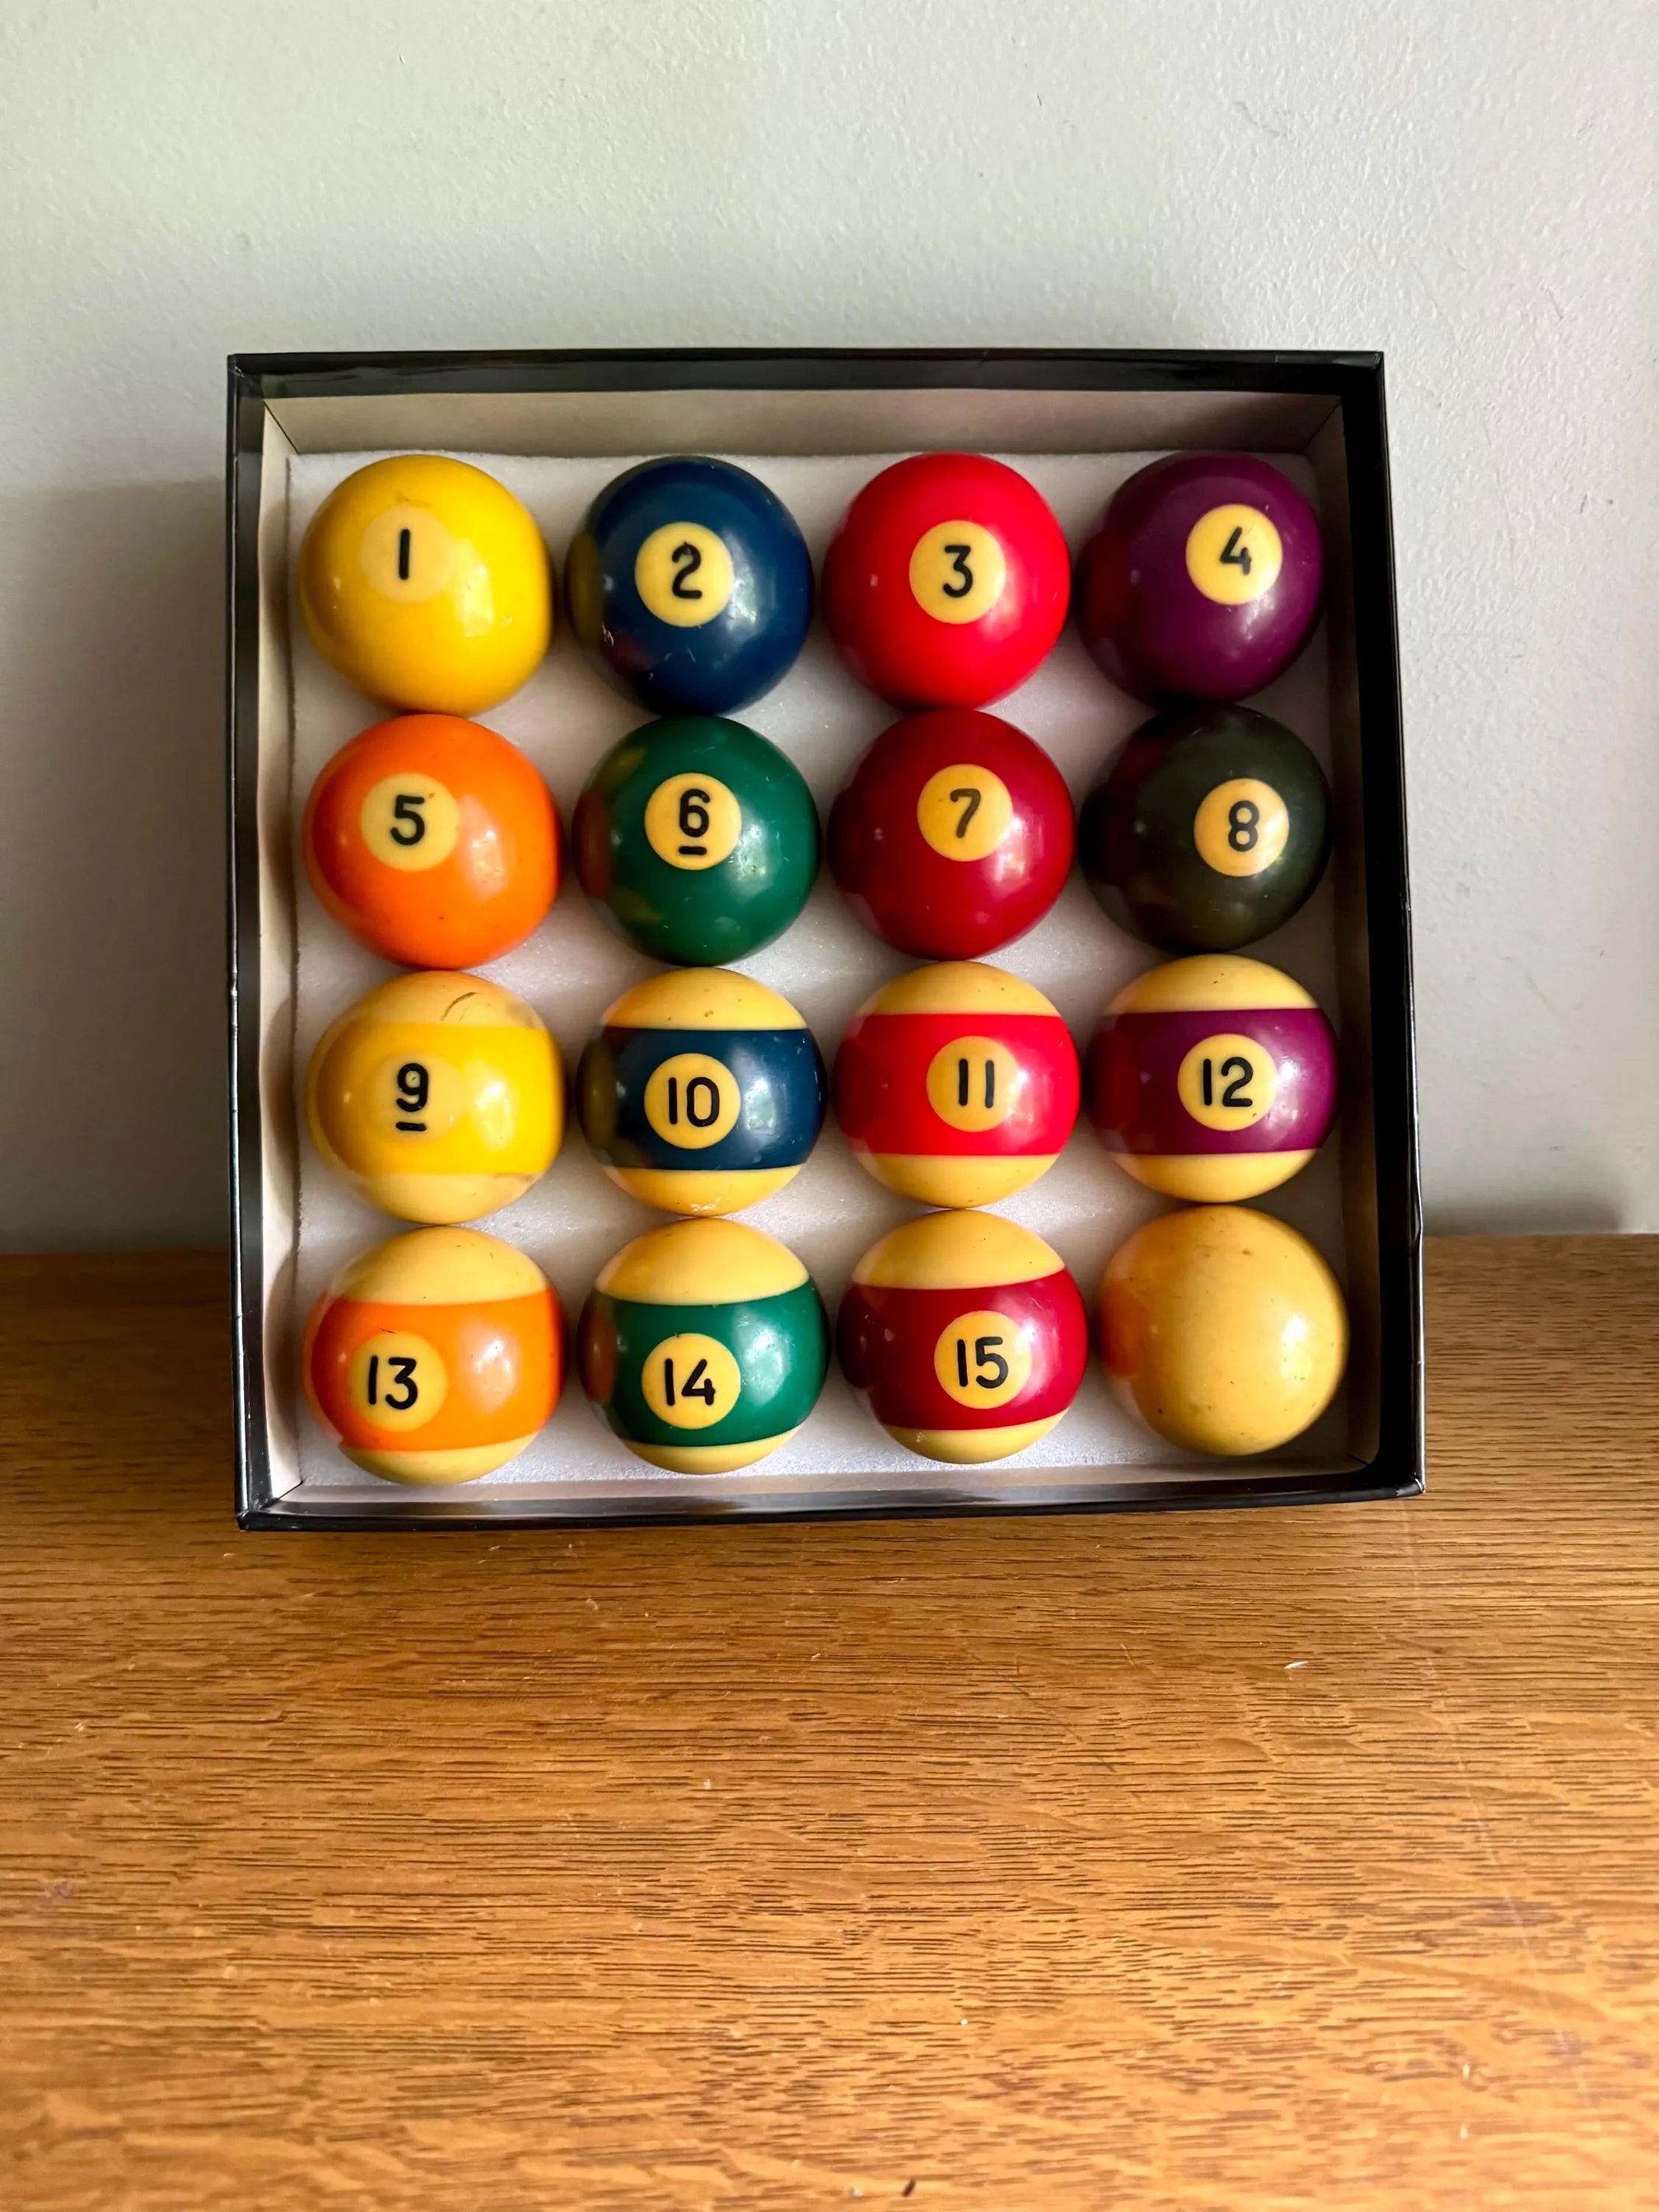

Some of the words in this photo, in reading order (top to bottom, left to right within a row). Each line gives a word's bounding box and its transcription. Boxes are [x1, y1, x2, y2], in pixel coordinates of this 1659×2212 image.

[399, 529, 411, 580] 1
[671, 542, 703, 599] 2
[942, 544, 973, 599] 3
[1220, 527, 1251, 575] 4
[390, 794, 425, 846] 5
[678, 788, 710, 838] 6
[950, 788, 981, 838] 7
[1228, 800, 1260, 852] 8
[396, 1062, 429, 1113] 9
[668, 1077, 720, 1128] 10
[959, 1058, 995, 1108] 11
[1202, 1057, 1253, 1107] 12
[368, 1355, 418, 1411] 13
[664, 1358, 716, 1407] 14
[956, 1336, 1008, 1389] 15
